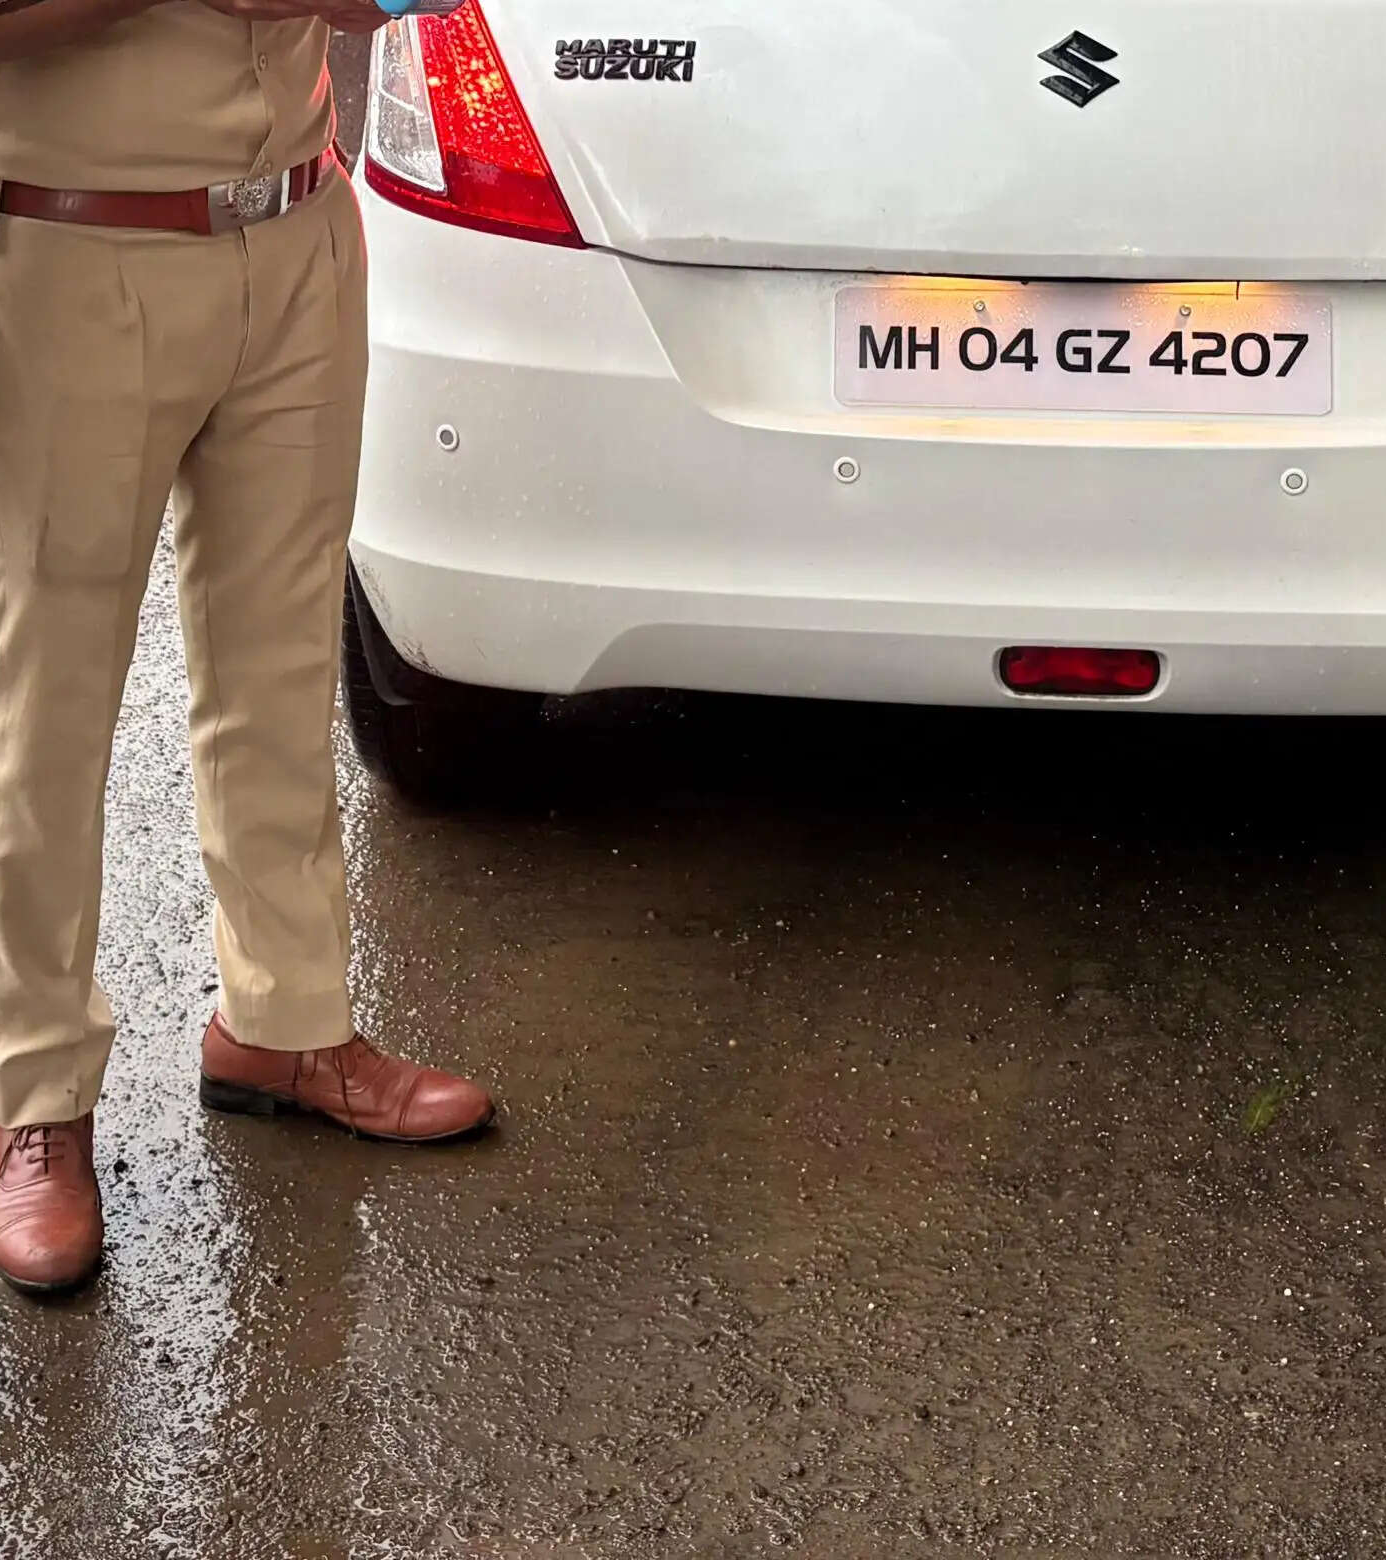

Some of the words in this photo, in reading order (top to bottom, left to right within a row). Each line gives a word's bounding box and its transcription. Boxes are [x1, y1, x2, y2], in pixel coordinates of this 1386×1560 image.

[555, 39, 697, 58] MARUTI
[554, 56, 694, 81] SUZUKI
[859, 325, 939, 370] MH
[958, 327, 1038, 372] 04
[1056, 329, 1131, 374] GZ
[1149, 331, 1309, 378] 4207
